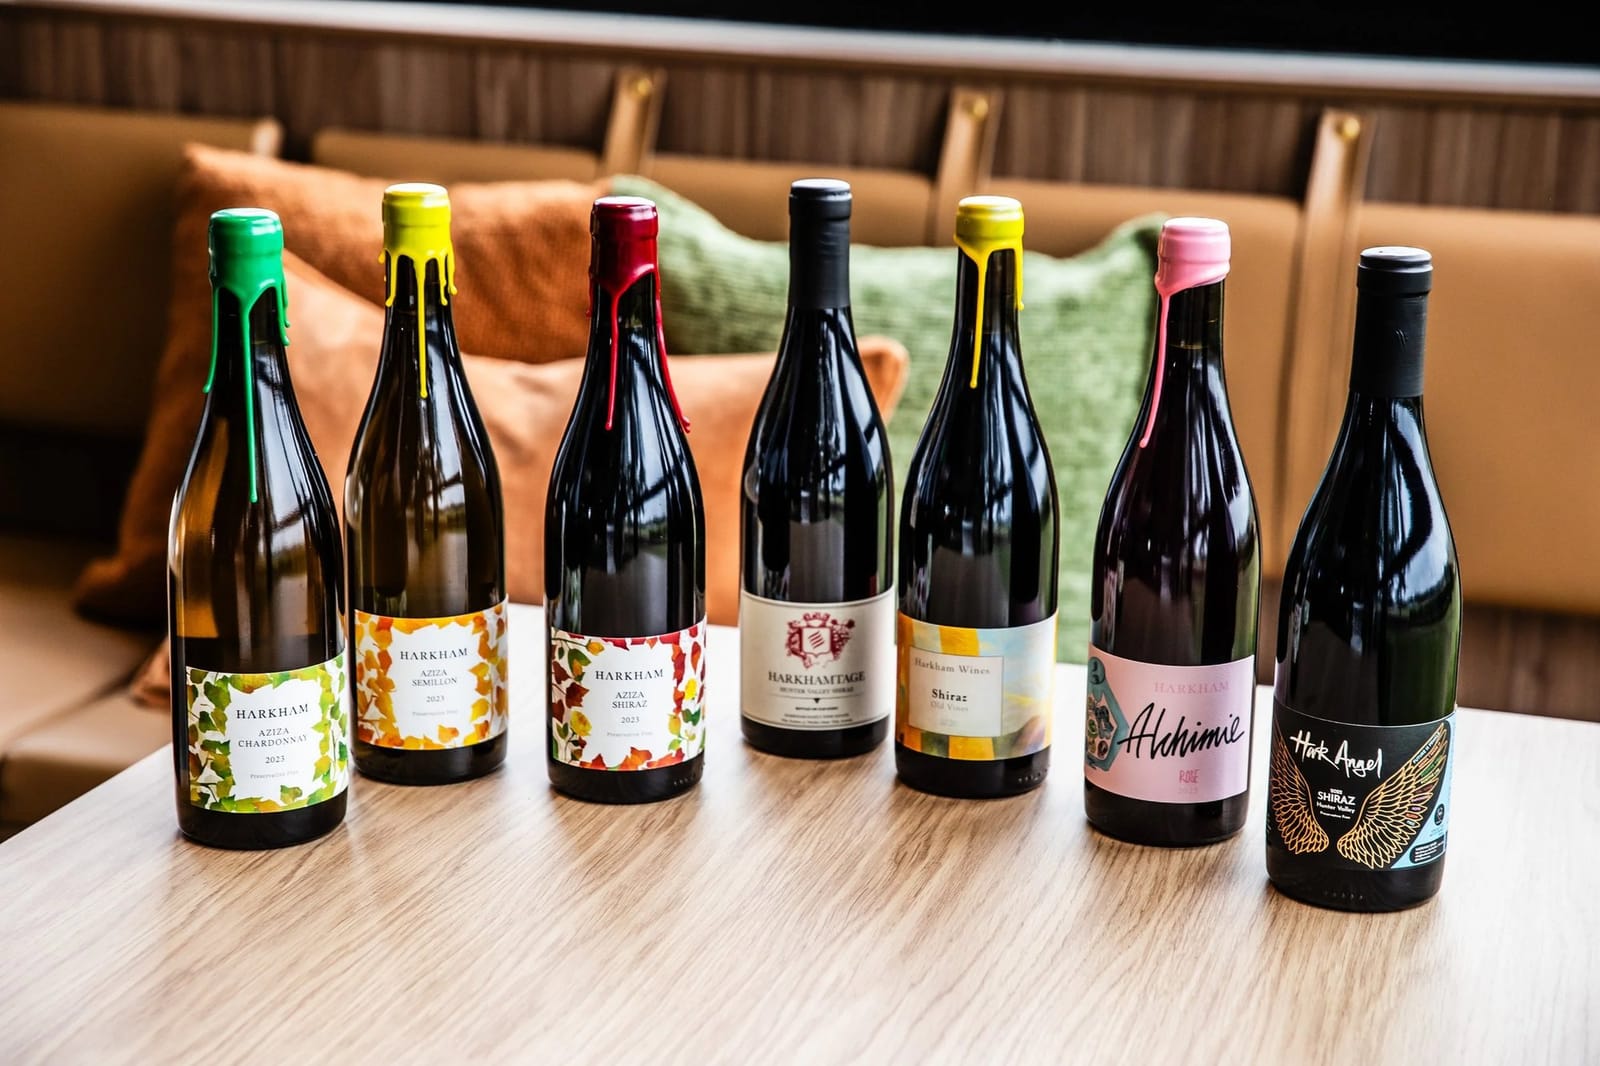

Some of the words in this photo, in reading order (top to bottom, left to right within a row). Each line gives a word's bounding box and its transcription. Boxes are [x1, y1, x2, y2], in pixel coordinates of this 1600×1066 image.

[400, 648, 468, 660] HARKHAM
[421, 669, 448, 677] AZIZA
[595, 669, 663, 681] HARKHAM
[768, 671, 866, 686] HARKHAMTAGE
[411, 678, 457, 687] SEMILLON
[1154, 681, 1230, 695] HARKHAM
[615, 691, 645, 699] AZIZA
[931, 688, 968, 702] Shiraz
[612, 700, 648, 709] SHIRAZ
[236, 703, 309, 719] HARKHAM
[621, 716, 640, 724] 2023
[258, 728, 290, 737] AZIZA
[238, 734, 307, 748] CHARDONNAY
[265, 755, 285, 764] 2023
[1289, 729, 1339, 770] Hark
[1334, 739, 1383, 779] Angel
[1317, 791, 1356, 806] SHIRAZ
